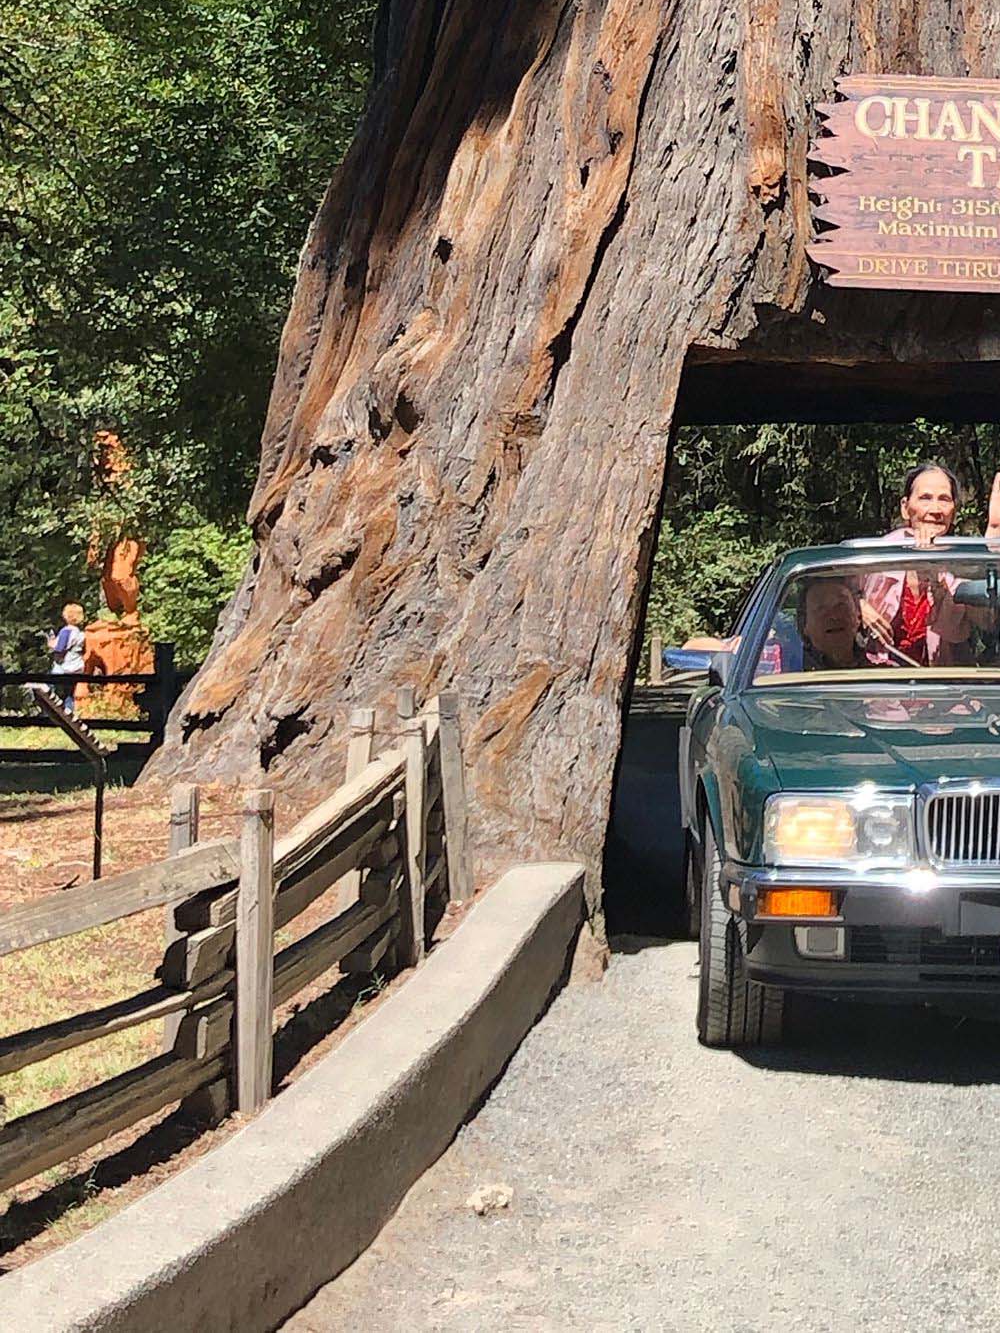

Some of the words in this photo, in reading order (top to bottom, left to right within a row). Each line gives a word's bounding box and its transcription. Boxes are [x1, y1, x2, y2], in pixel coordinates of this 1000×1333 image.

[858, 195, 942, 221] Height:
[878, 220, 998, 239] Maximum
[858, 257, 928, 274] DRIVE
[938, 260, 1000, 278] THRU
